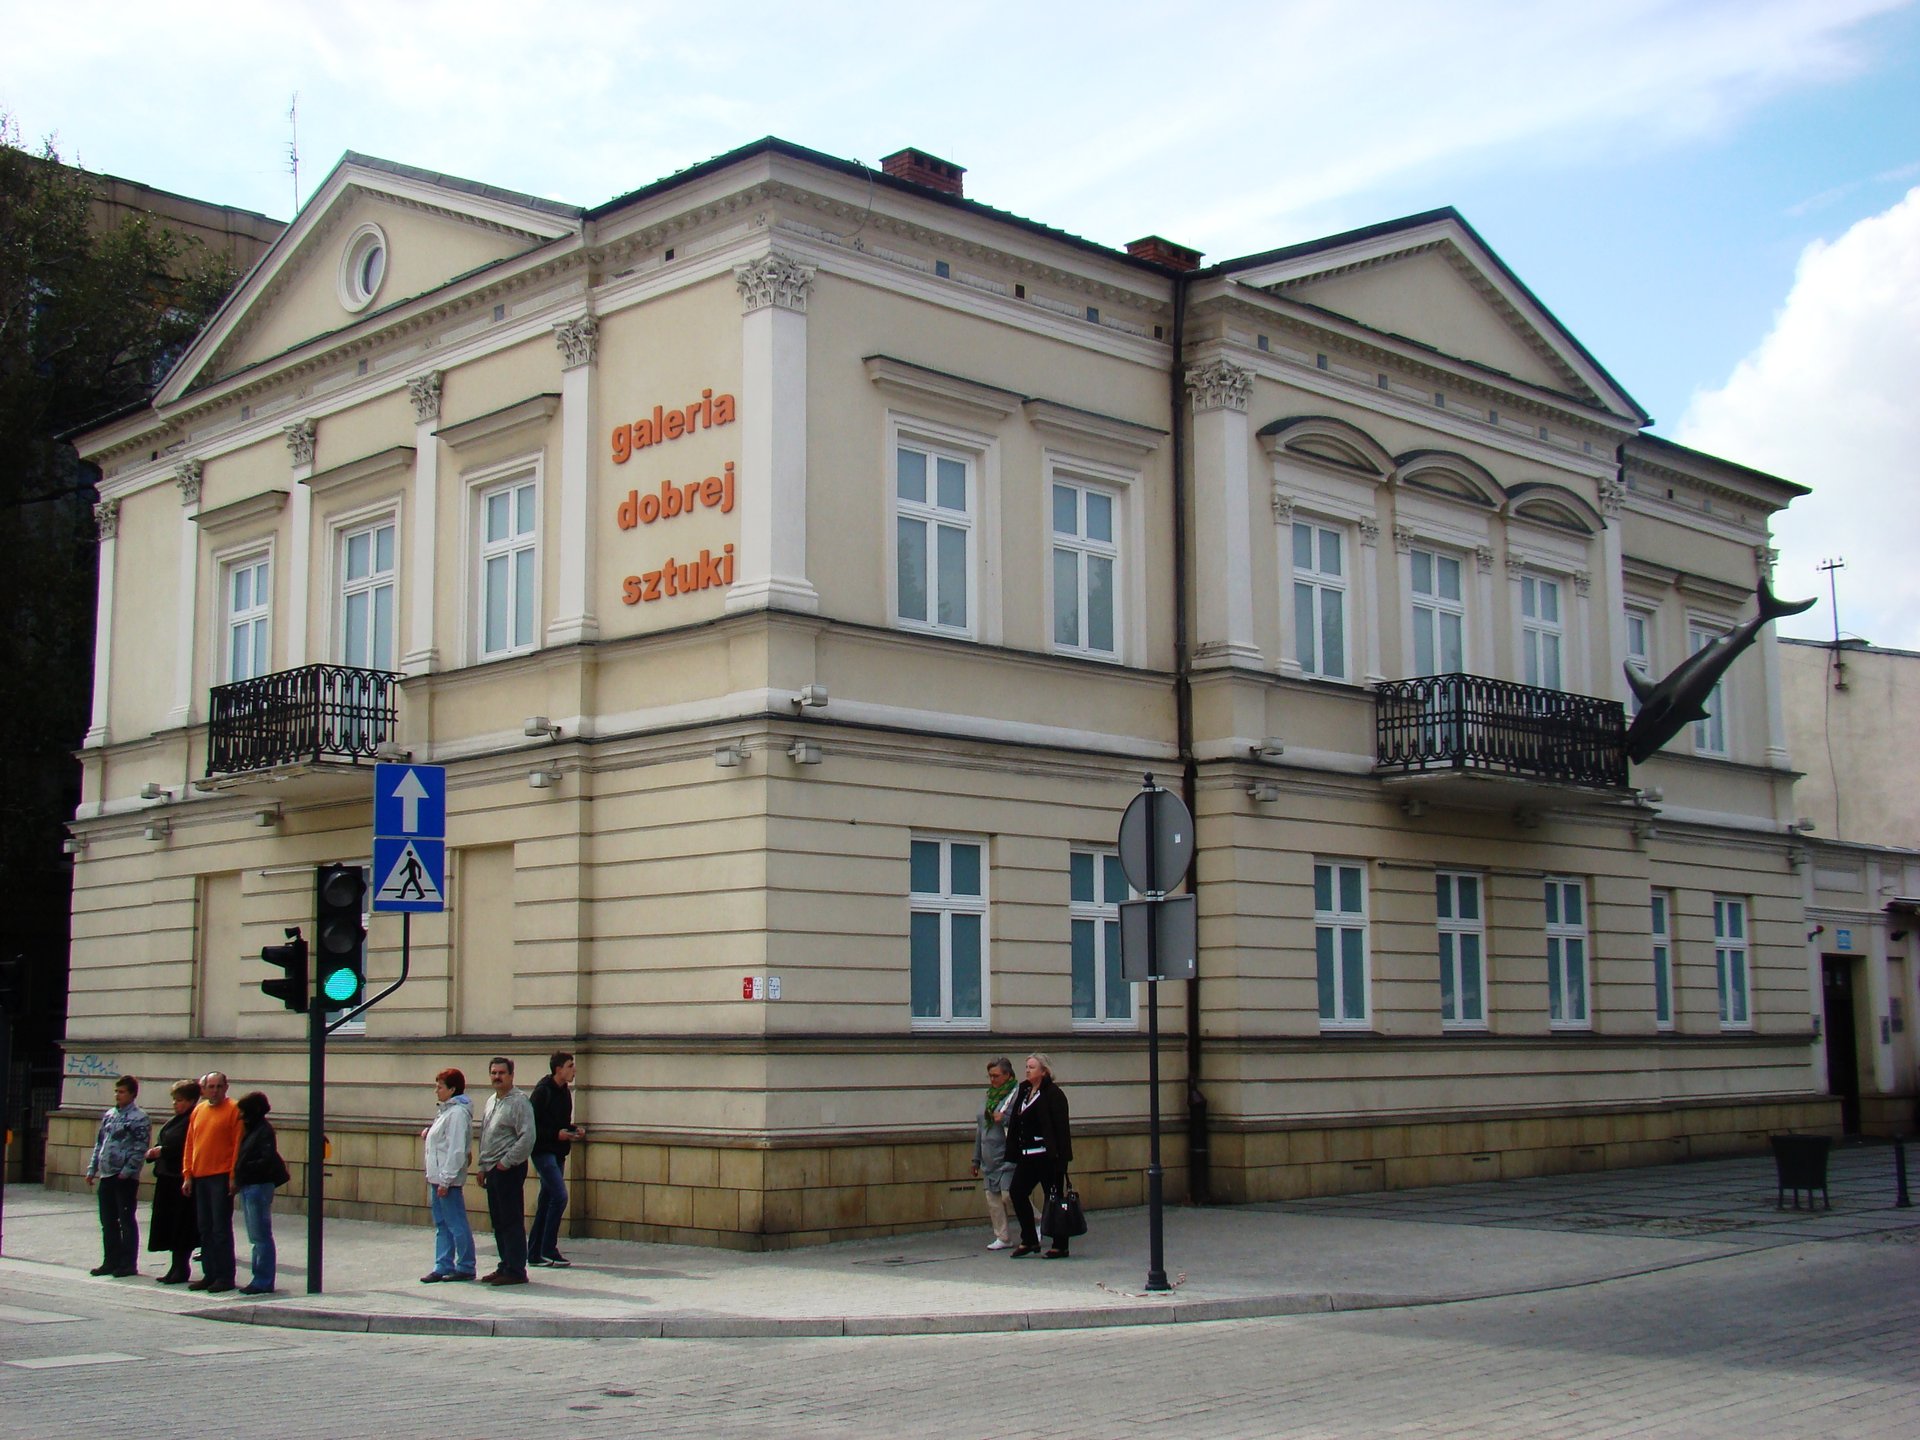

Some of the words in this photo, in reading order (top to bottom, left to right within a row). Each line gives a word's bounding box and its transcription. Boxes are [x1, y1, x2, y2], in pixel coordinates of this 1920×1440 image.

[611, 388, 735, 464] galeria
[617, 461, 735, 531] dobrej
[622, 543, 734, 605] sztuki
